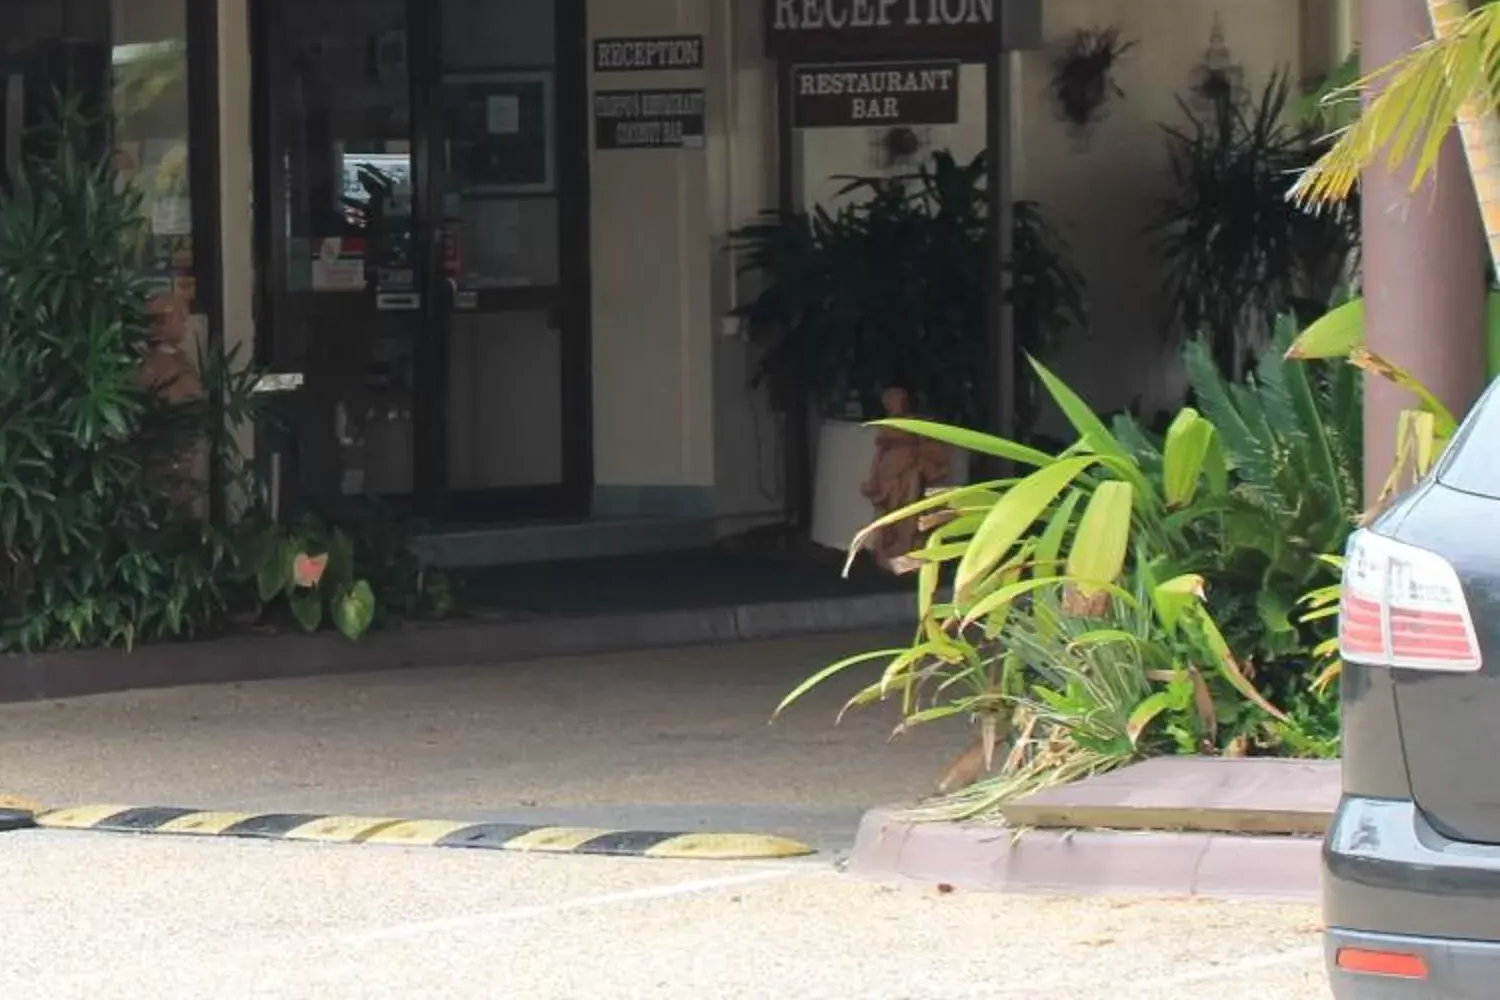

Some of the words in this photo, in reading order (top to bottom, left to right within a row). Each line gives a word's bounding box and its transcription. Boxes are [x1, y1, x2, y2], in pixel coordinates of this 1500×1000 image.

[596, 40, 700, 68] RECEPTION
[800, 69, 952, 96] RESTAURANT
[851, 97, 900, 119] BAR
